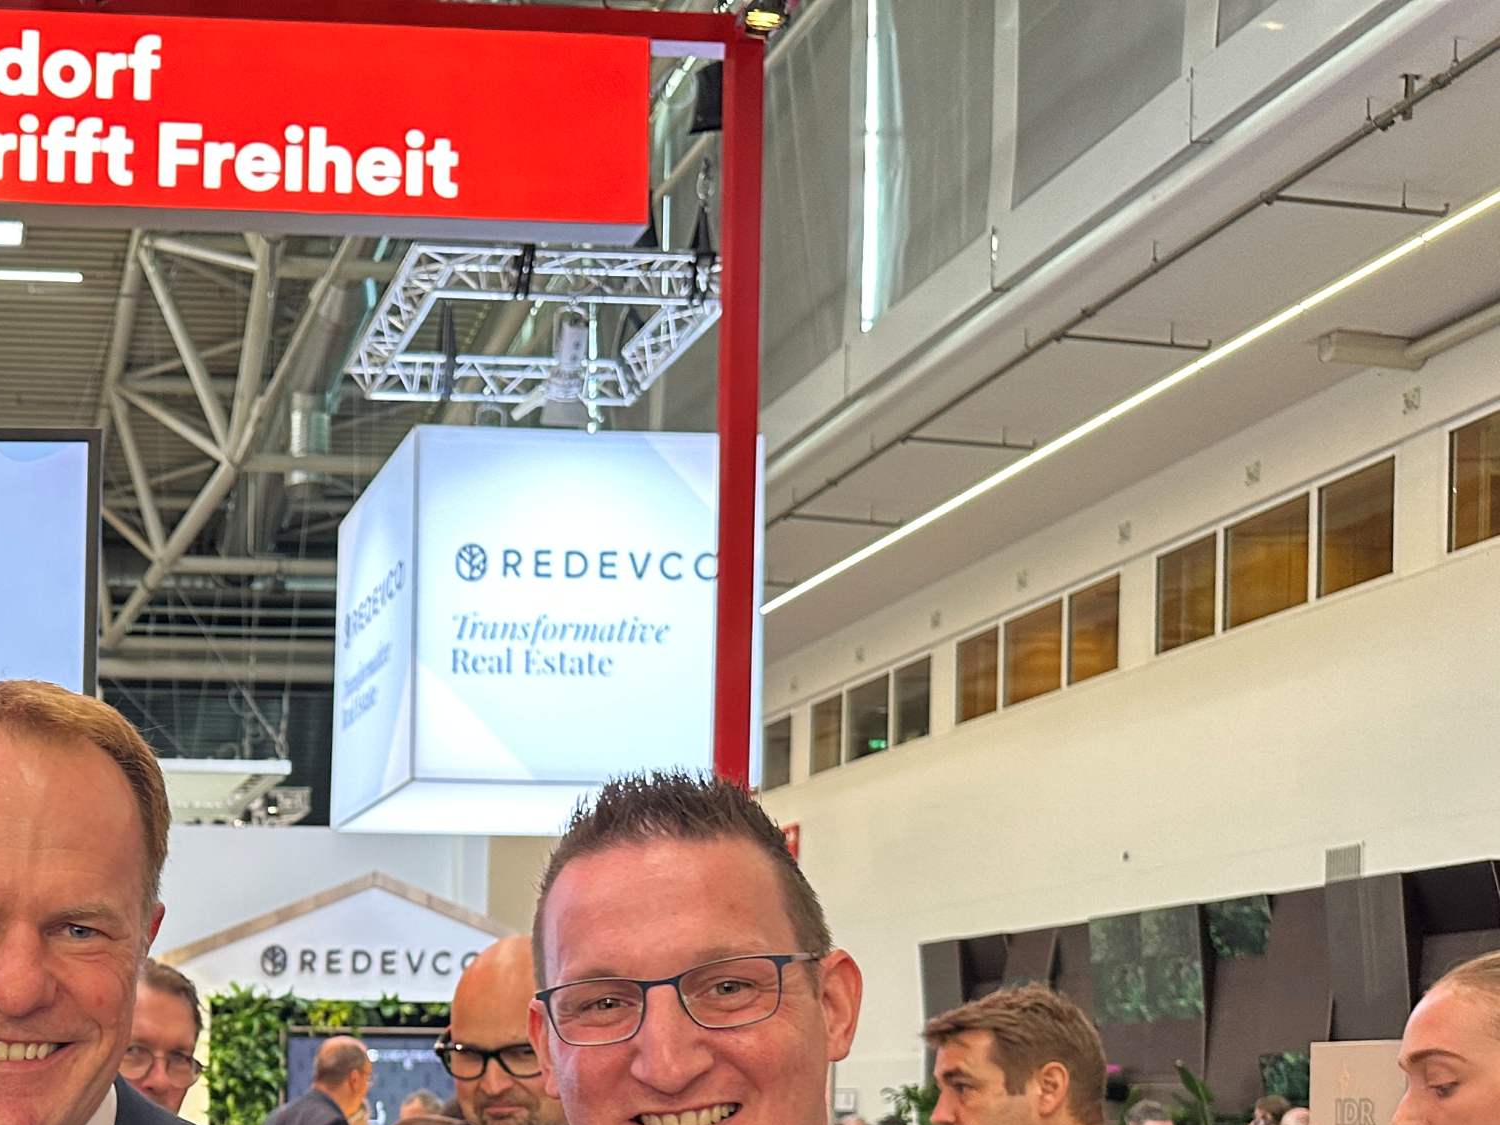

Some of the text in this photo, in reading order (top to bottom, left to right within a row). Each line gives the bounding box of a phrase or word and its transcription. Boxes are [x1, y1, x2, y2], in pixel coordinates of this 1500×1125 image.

[157, 122, 459, 198] Freiheit
[503, 549, 719, 580] REDEVCO
[452, 614, 670, 646] Transformative
[451, 648, 614, 677] Real Estate
